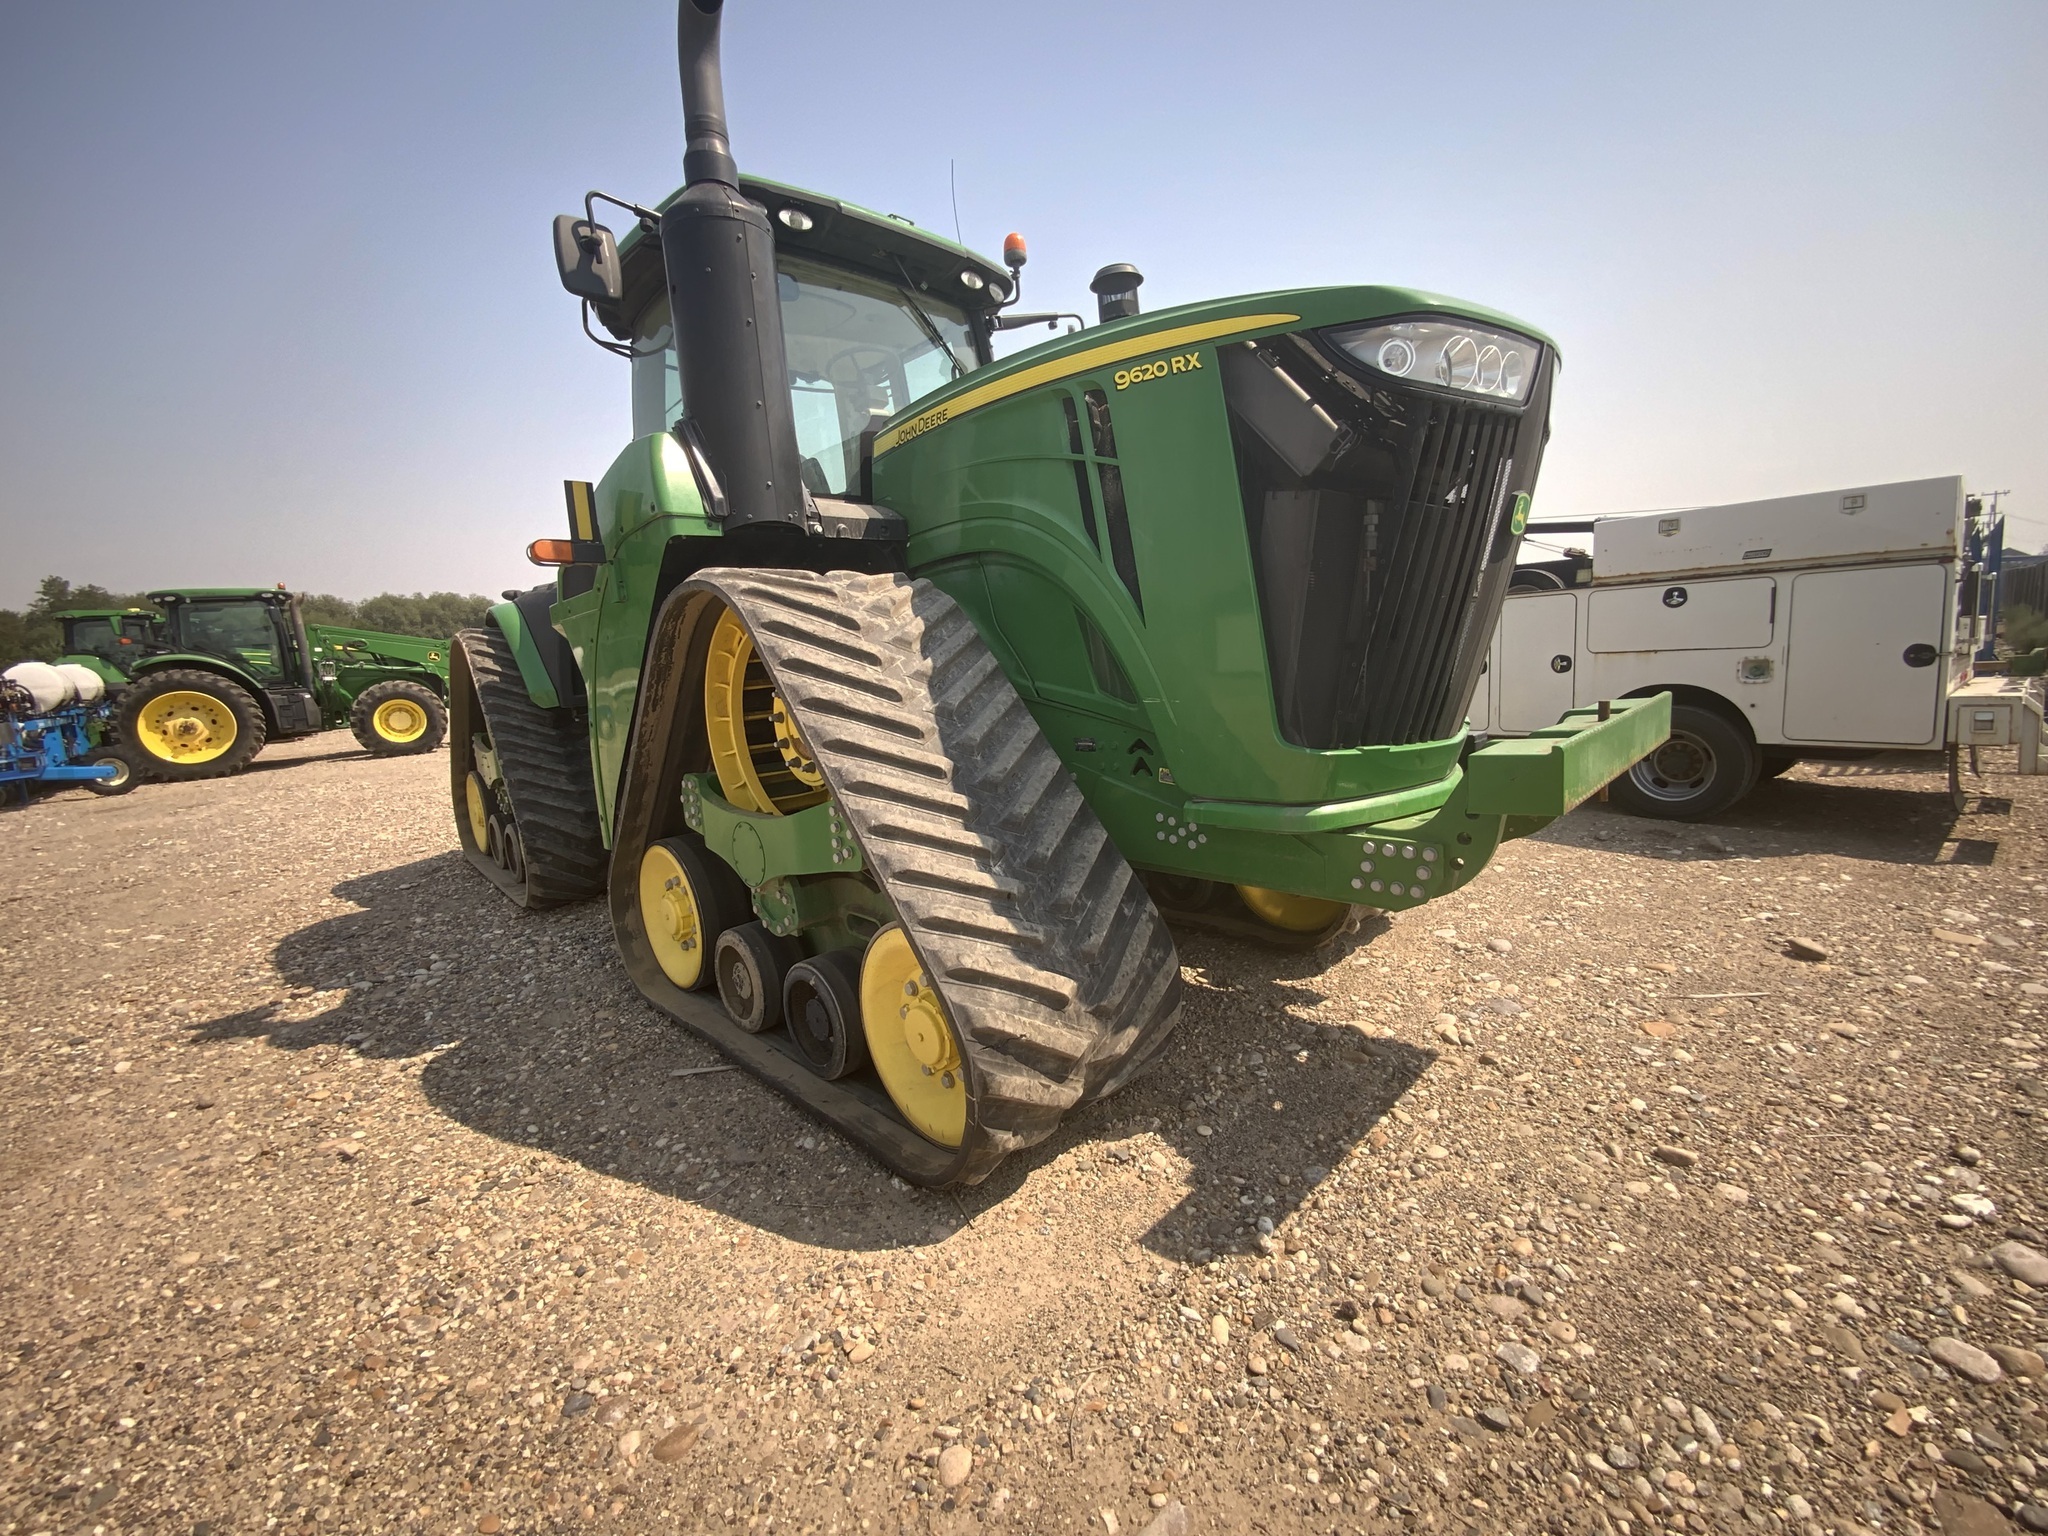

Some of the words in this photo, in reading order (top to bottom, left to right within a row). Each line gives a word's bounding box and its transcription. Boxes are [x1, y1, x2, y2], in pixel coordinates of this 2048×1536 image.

[1114, 360, 1168, 390] 9620
[1170, 351, 1203, 374] RX
[895, 422, 918, 446] JOHN
[917, 408, 949, 433] DEERE
